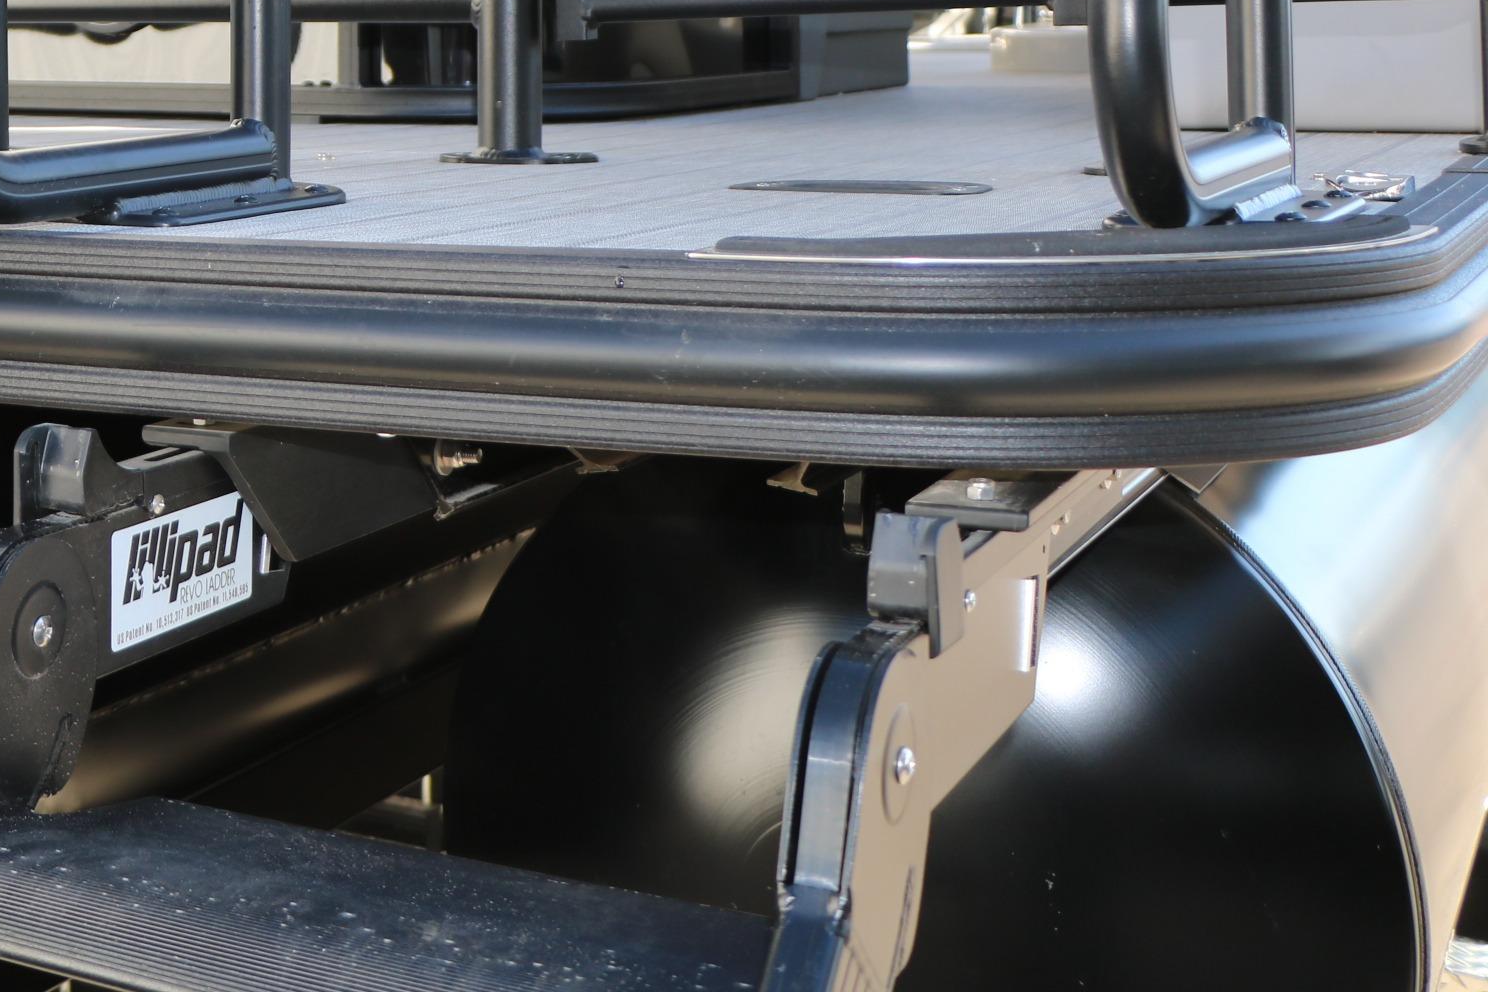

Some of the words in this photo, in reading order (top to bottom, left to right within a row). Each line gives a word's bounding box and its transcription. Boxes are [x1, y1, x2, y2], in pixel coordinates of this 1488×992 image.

[180, 580, 203, 605] REVO
[205, 569, 236, 596] LADDER
[117, 631, 124, 645] US
[125, 624, 144, 642] Patent
